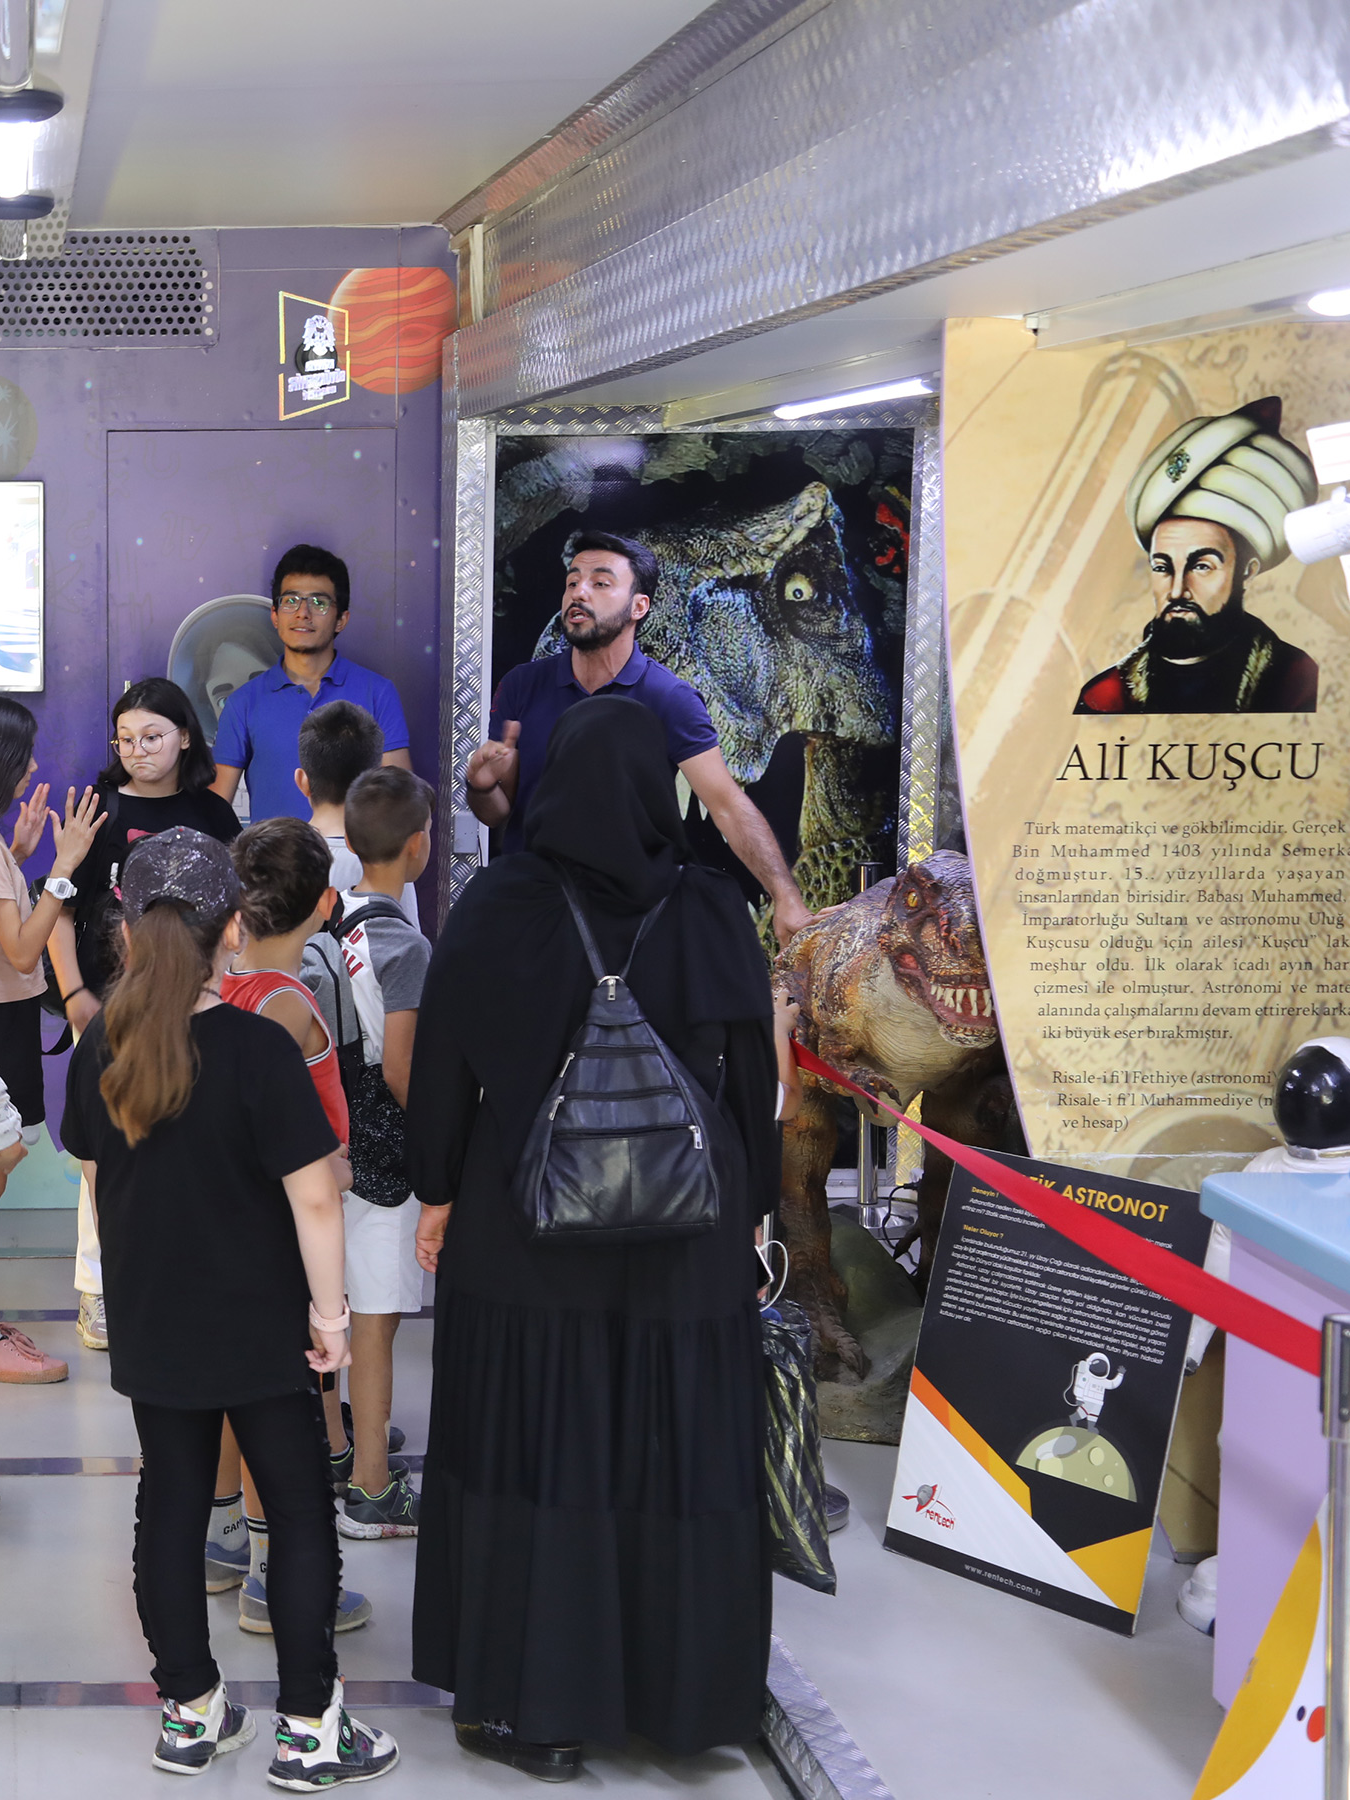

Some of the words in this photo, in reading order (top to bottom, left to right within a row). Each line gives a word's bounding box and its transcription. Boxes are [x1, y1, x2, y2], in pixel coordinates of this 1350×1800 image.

[1024, 820, 1060, 834] Türk
[1064, 820, 1157, 838] matematikçi
[1161, 824, 1178, 834] ve
[1182, 820, 1288, 838] gökbilimcidir.
[1292, 820, 1347, 838] Gerçek
[1012, 843, 1040, 857] Bin
[1051, 843, 1151, 857] Muhammed
[1162, 843, 1202, 857] 1403
[1211, 843, 1271, 861] yılında
[1014, 866, 1113, 884] doğmuştur.
[1166, 866, 1266, 884] yüzyıllarda
[1276, 870, 1345, 884] yaşayan
[1017, 888, 1120, 903] insanlarından
[1126, 888, 1190, 903] birisidir.
[1197, 888, 1244, 903] Babası
[1022, 910, 1129, 930] İmparatorluğu
[1196, 916, 1213, 926] ve
[1220, 912, 1300, 926] astronomu
[1308, 912, 1345, 930] Uluğ
[1026, 934, 1090, 953] Kuşcusu
[1099, 934, 1153, 953] olduğu
[1163, 934, 1193, 953] için
[1202, 934, 1244, 949] ailesi
[1030, 956, 1088, 975] meşhur
[1095, 956, 1134, 971] oldu.
[1144, 955, 1166, 971] İlk
[1175, 956, 1223, 971] olarak
[1233, 956, 1270, 971] icadı
[1279, 960, 1313, 975] ayın
[1033, 980, 1089, 998] çizmesi
[1096, 980, 1115, 994] ile
[1122, 980, 1194, 998] olmuştur.
[1201, 980, 1282, 994] Astronomi
[1290, 984, 1308, 994] ve
[1037, 1002, 1101, 1016] alanında
[1104, 1002, 1199, 1020] çalışmalarını
[1202, 1002, 1251, 1016] devam
[1254, 1002, 1320, 1016] ettirerek
[1043, 1024, 1062, 1039] iki
[1064, 1024, 1111, 1043] büyük
[1114, 1028, 1144, 1039] eser
[1146, 1024, 1233, 1043] bırakmıştır.
[1052, 1070, 1107, 1084] Risale-i
[1132, 1070, 1188, 1088] Fethiye
[1057, 1092, 1112, 1106] Risale-i
[1140, 1092, 1253, 1110] Muhammediye
[1062, 1118, 1079, 1129] ve
[1082, 1114, 1130, 1133] hesap)
[1061, 1184, 1169, 1222] ASTRONOT
[925, 1509, 955, 1530] rentech
[964, 1563, 1042, 1597] www.rentech.com.tr
